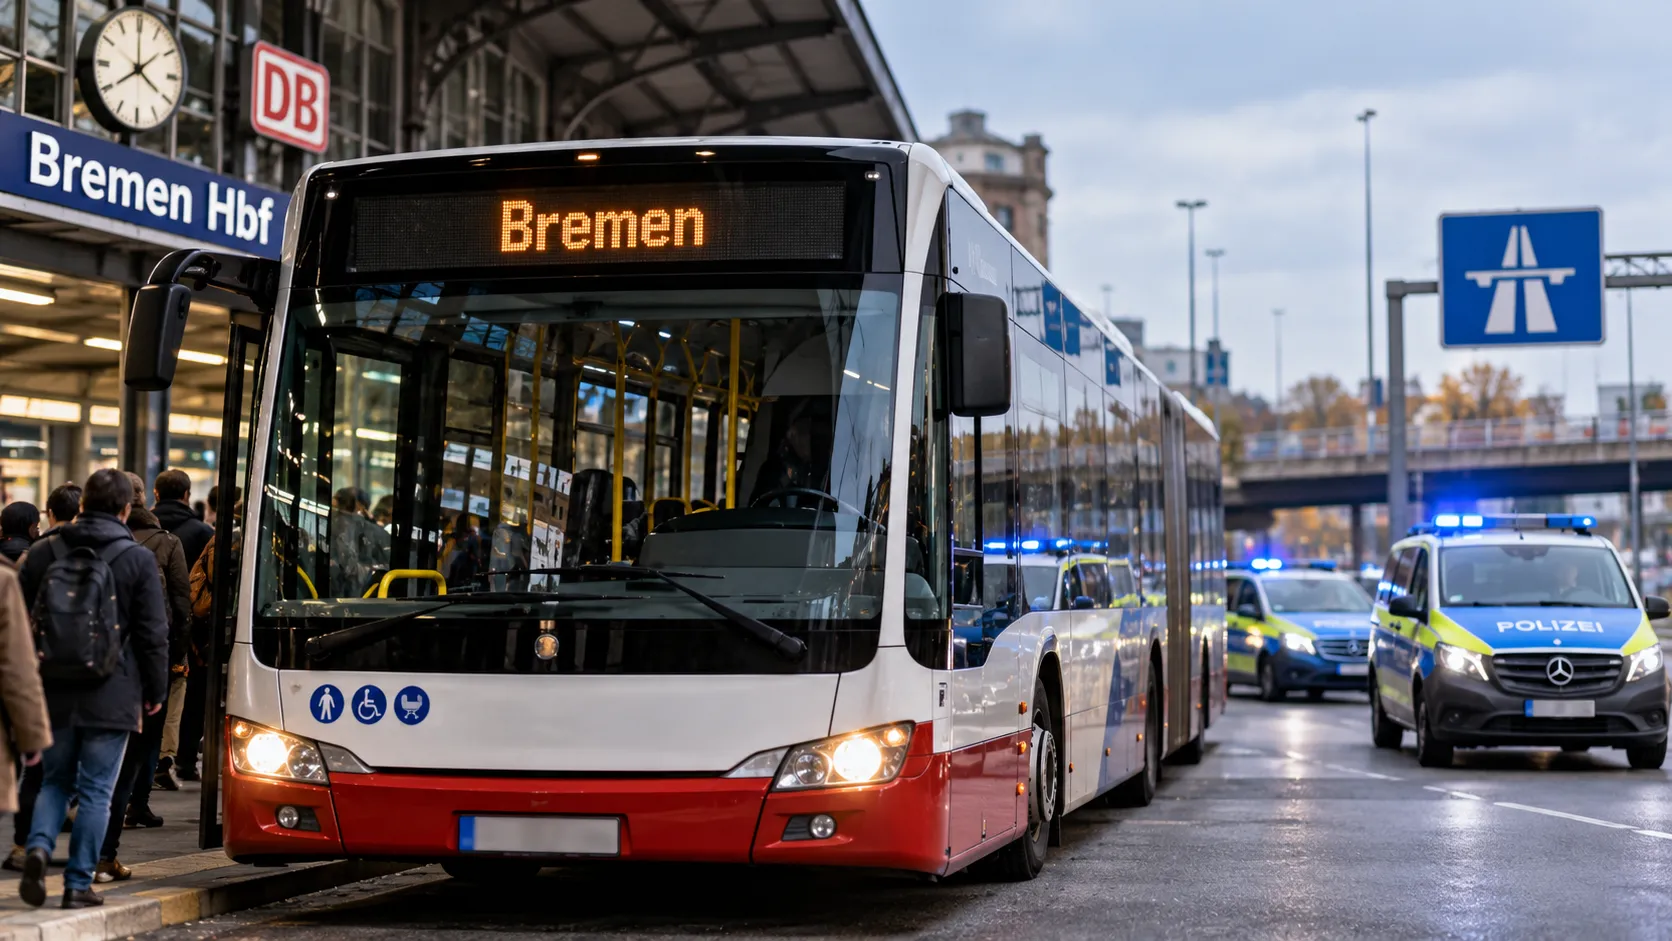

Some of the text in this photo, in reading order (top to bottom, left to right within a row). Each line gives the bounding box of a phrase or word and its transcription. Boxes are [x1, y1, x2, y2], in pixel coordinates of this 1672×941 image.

[263, 61, 318, 134] DB
[30, 131, 274, 245] Bremen Hbf
[501, 200, 704, 252] Bremen
[1496, 619, 1604, 633] POLIZEI
